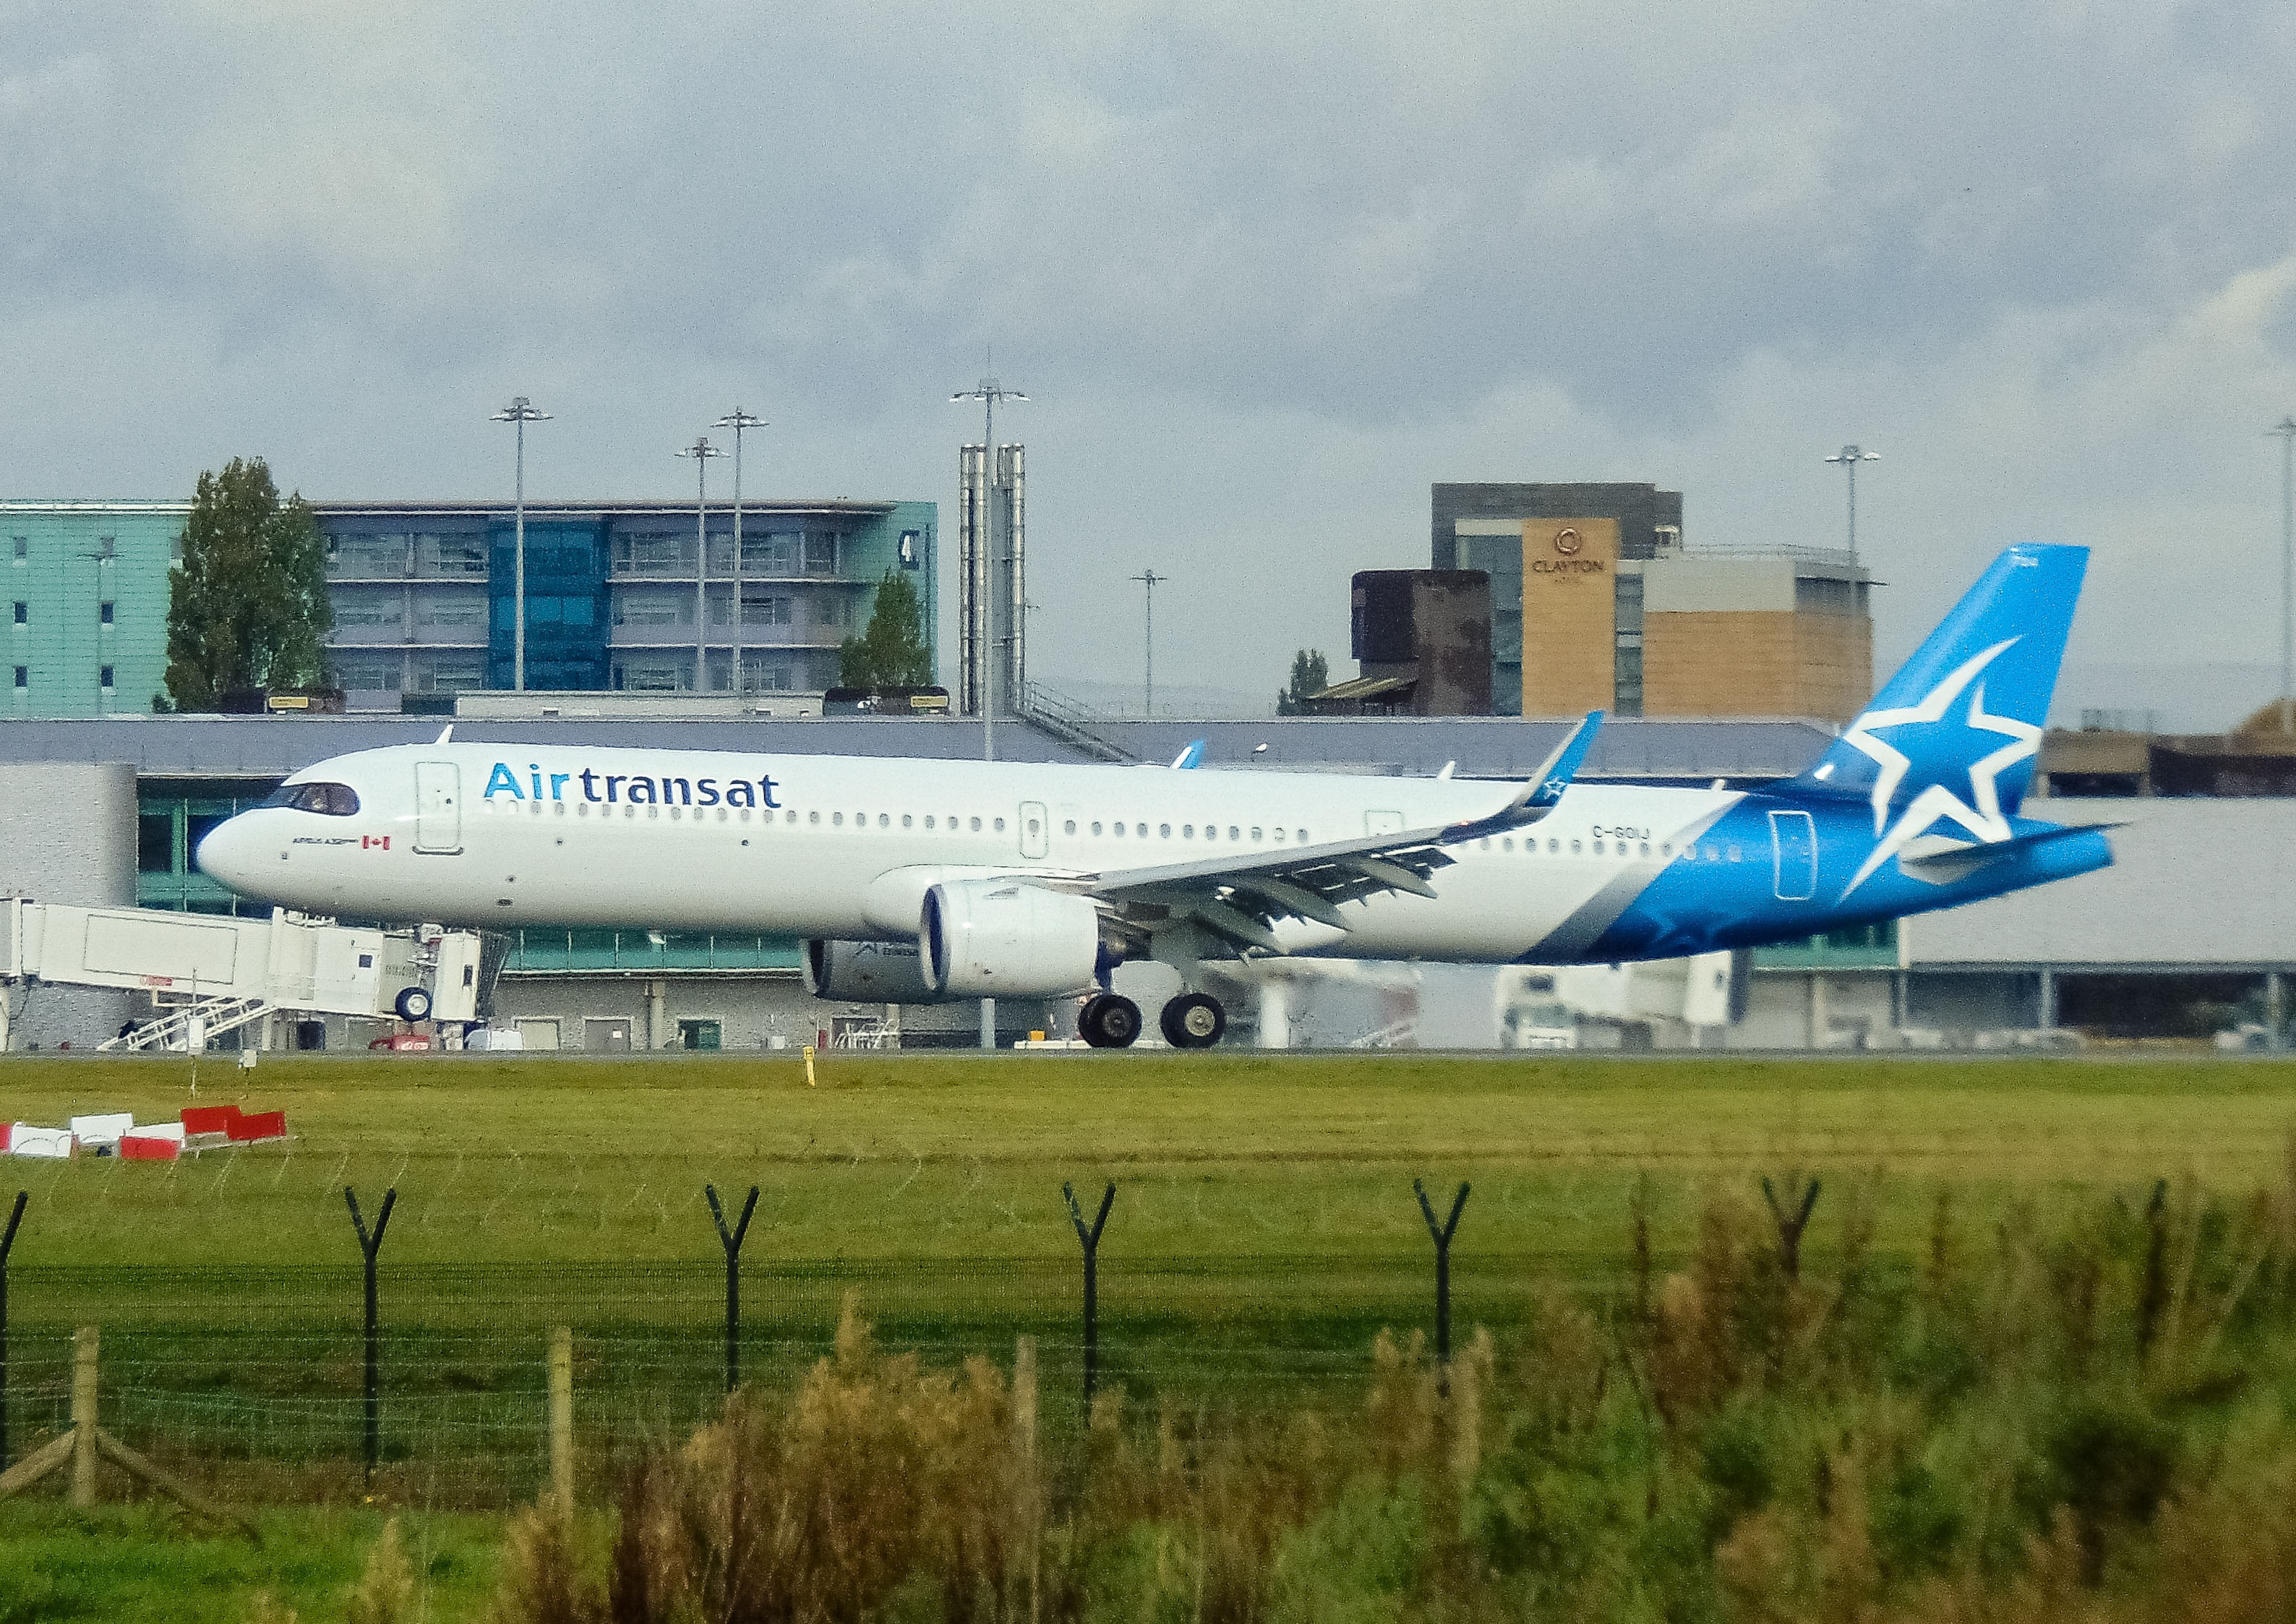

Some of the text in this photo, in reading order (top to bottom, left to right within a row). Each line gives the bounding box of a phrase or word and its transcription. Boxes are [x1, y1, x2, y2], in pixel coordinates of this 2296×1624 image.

[1532, 560, 1604, 573] CLAYTON
[484, 762, 781, 808] Air transat
